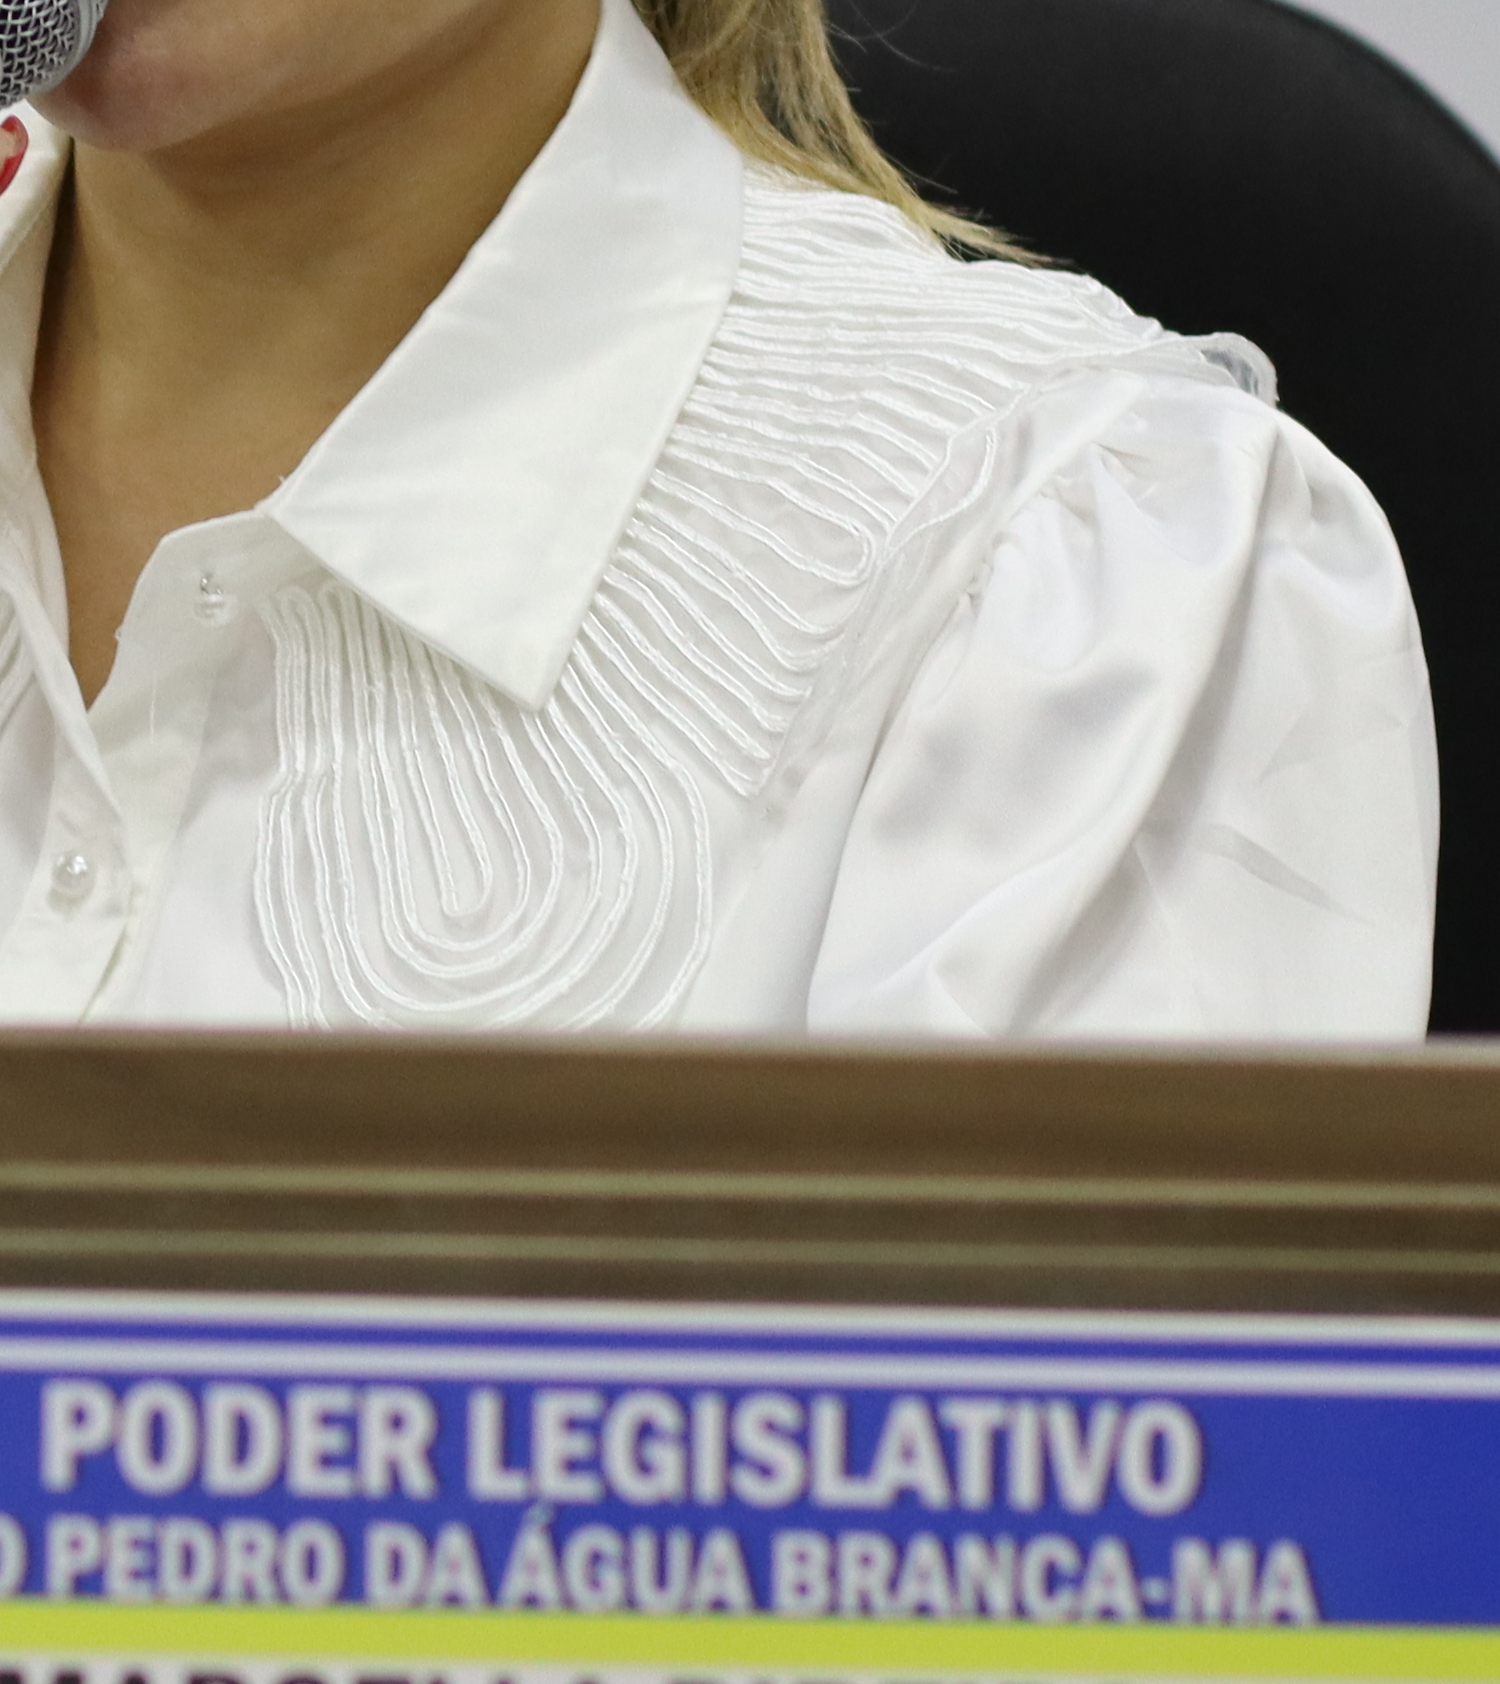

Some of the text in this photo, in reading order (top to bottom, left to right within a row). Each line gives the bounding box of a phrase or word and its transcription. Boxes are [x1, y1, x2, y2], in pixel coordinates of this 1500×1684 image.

[39, 1377, 1203, 1516] PODER LEGISLATIVO
[44, 1514, 347, 1607] PEDRO
[363, 1521, 492, 1610] DA
[502, 1499, 758, 1615] ÁGUA
[769, 1528, 1320, 1626] BRANCA-MA
